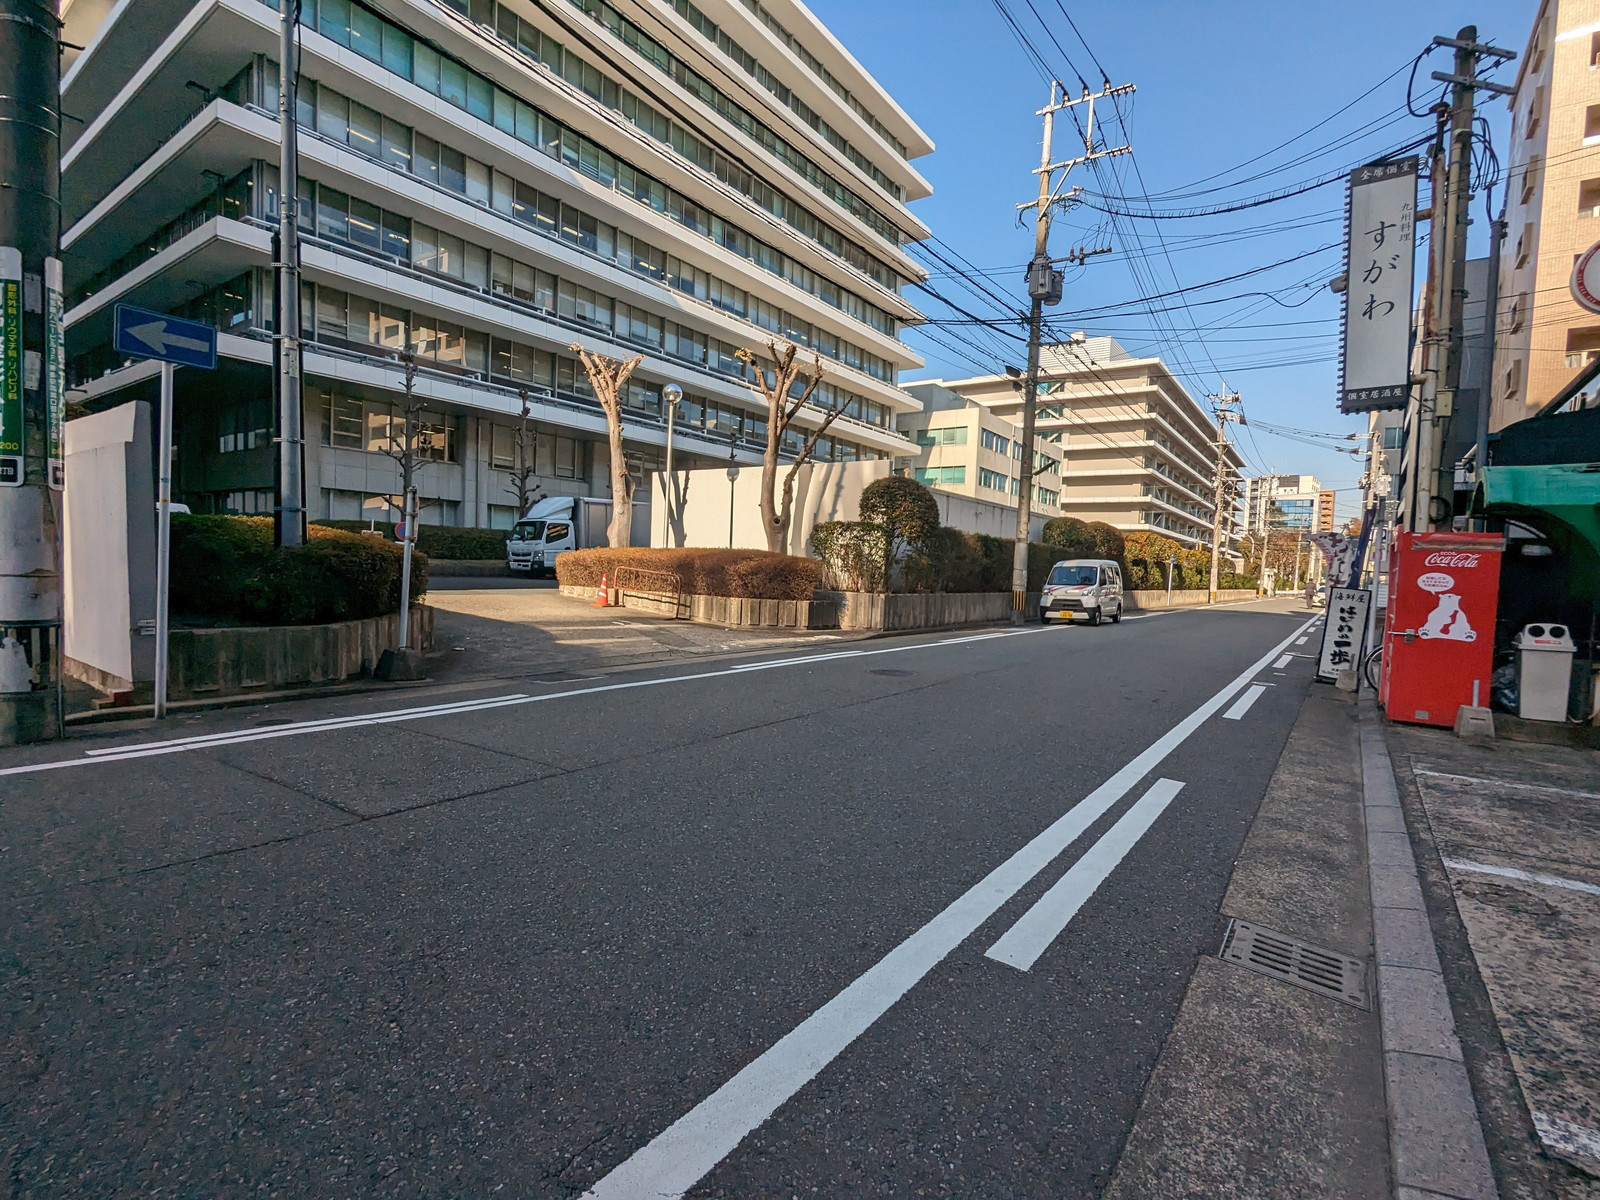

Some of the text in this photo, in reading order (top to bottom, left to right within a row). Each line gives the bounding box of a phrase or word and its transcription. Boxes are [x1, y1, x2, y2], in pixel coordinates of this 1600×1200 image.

[1360, 161, 1412, 181] 全席個室
[1398, 202, 1413, 242] 九州料理
[1362, 221, 1400, 321] すがわ
[1347, 387, 1403, 401] 個室居酒屋
[1424, 552, 1481, 568] Coca-Cola
[1334, 592, 1366, 603] 海鮮屋
[1330, 605, 1358, 666] はじめの一歩
